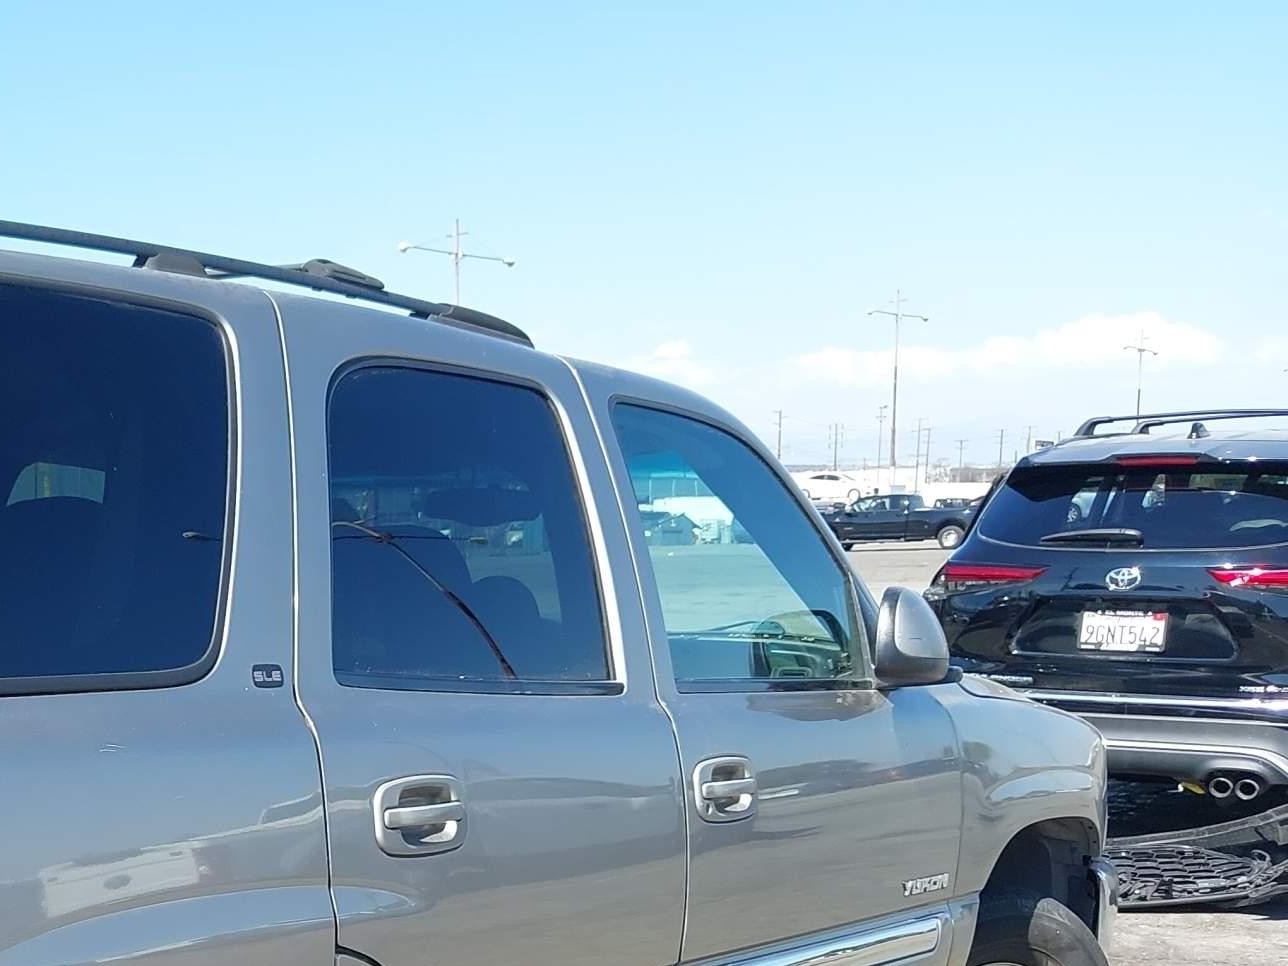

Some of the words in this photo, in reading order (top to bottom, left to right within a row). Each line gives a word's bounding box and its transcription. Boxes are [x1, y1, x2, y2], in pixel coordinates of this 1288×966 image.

[1085, 624, 1160, 645] 9GNT542
[253, 670, 282, 682] SLE
[901, 871, 950, 897] YUKON
